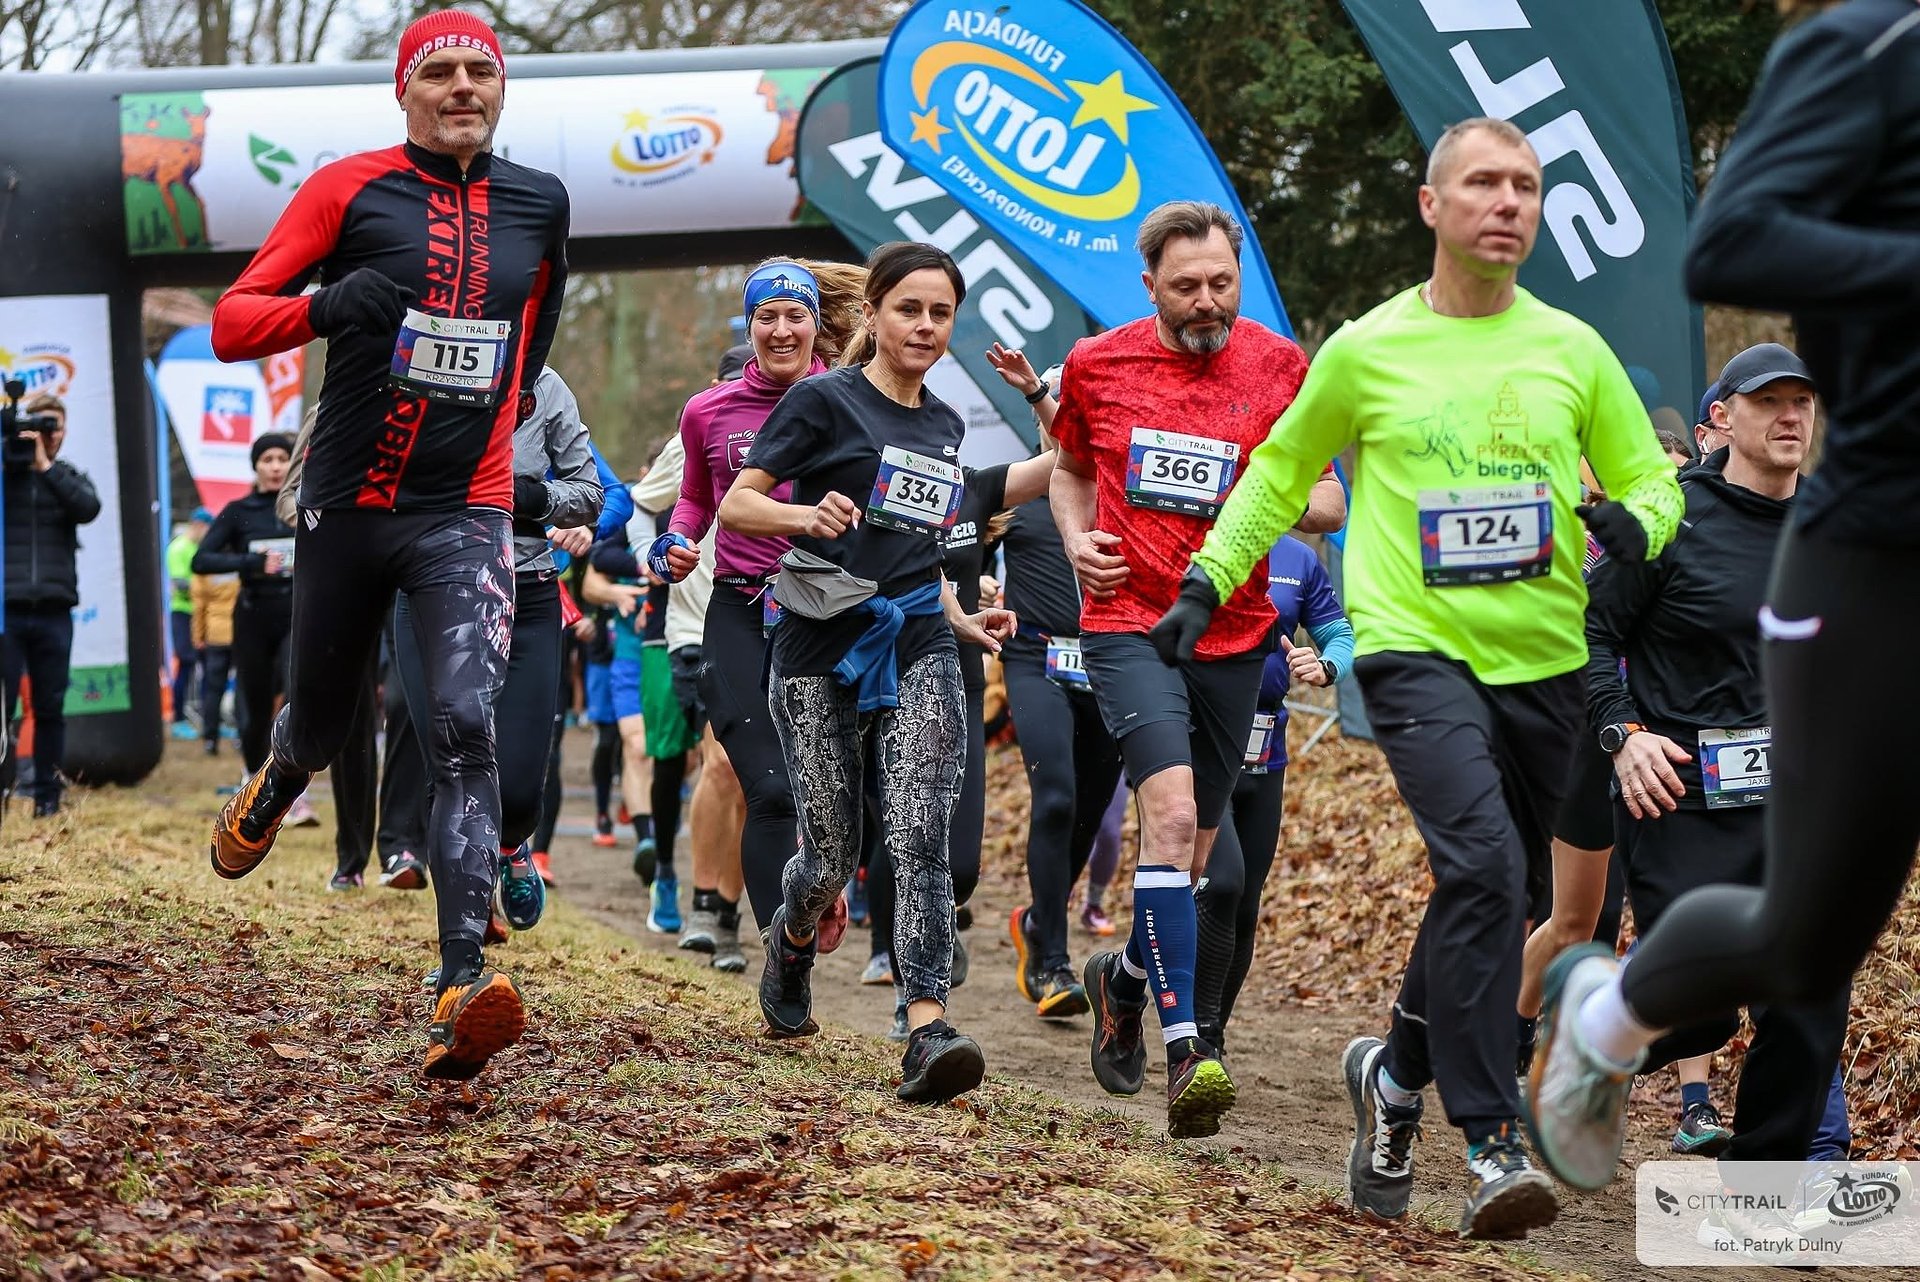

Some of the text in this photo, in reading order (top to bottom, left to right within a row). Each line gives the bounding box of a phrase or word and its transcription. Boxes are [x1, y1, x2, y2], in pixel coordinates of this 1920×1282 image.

[634, 126, 701, 160] LOTTO
[421, 188, 462, 316] EXTRE
[463, 215, 490, 318] RUNNING
[433, 342, 480, 372] 115
[425, 372, 480, 386] KRZYSZTOF
[355, 393, 427, 502] OBBY
[1151, 454, 1211, 484] 366
[896, 475, 940, 509] 334
[1456, 515, 1521, 546] 124
[1063, 653, 1084, 669] 11
[1738, 727, 1771, 738] CITYTR
[1145, 908, 1168, 989] COMPRESSPORT
